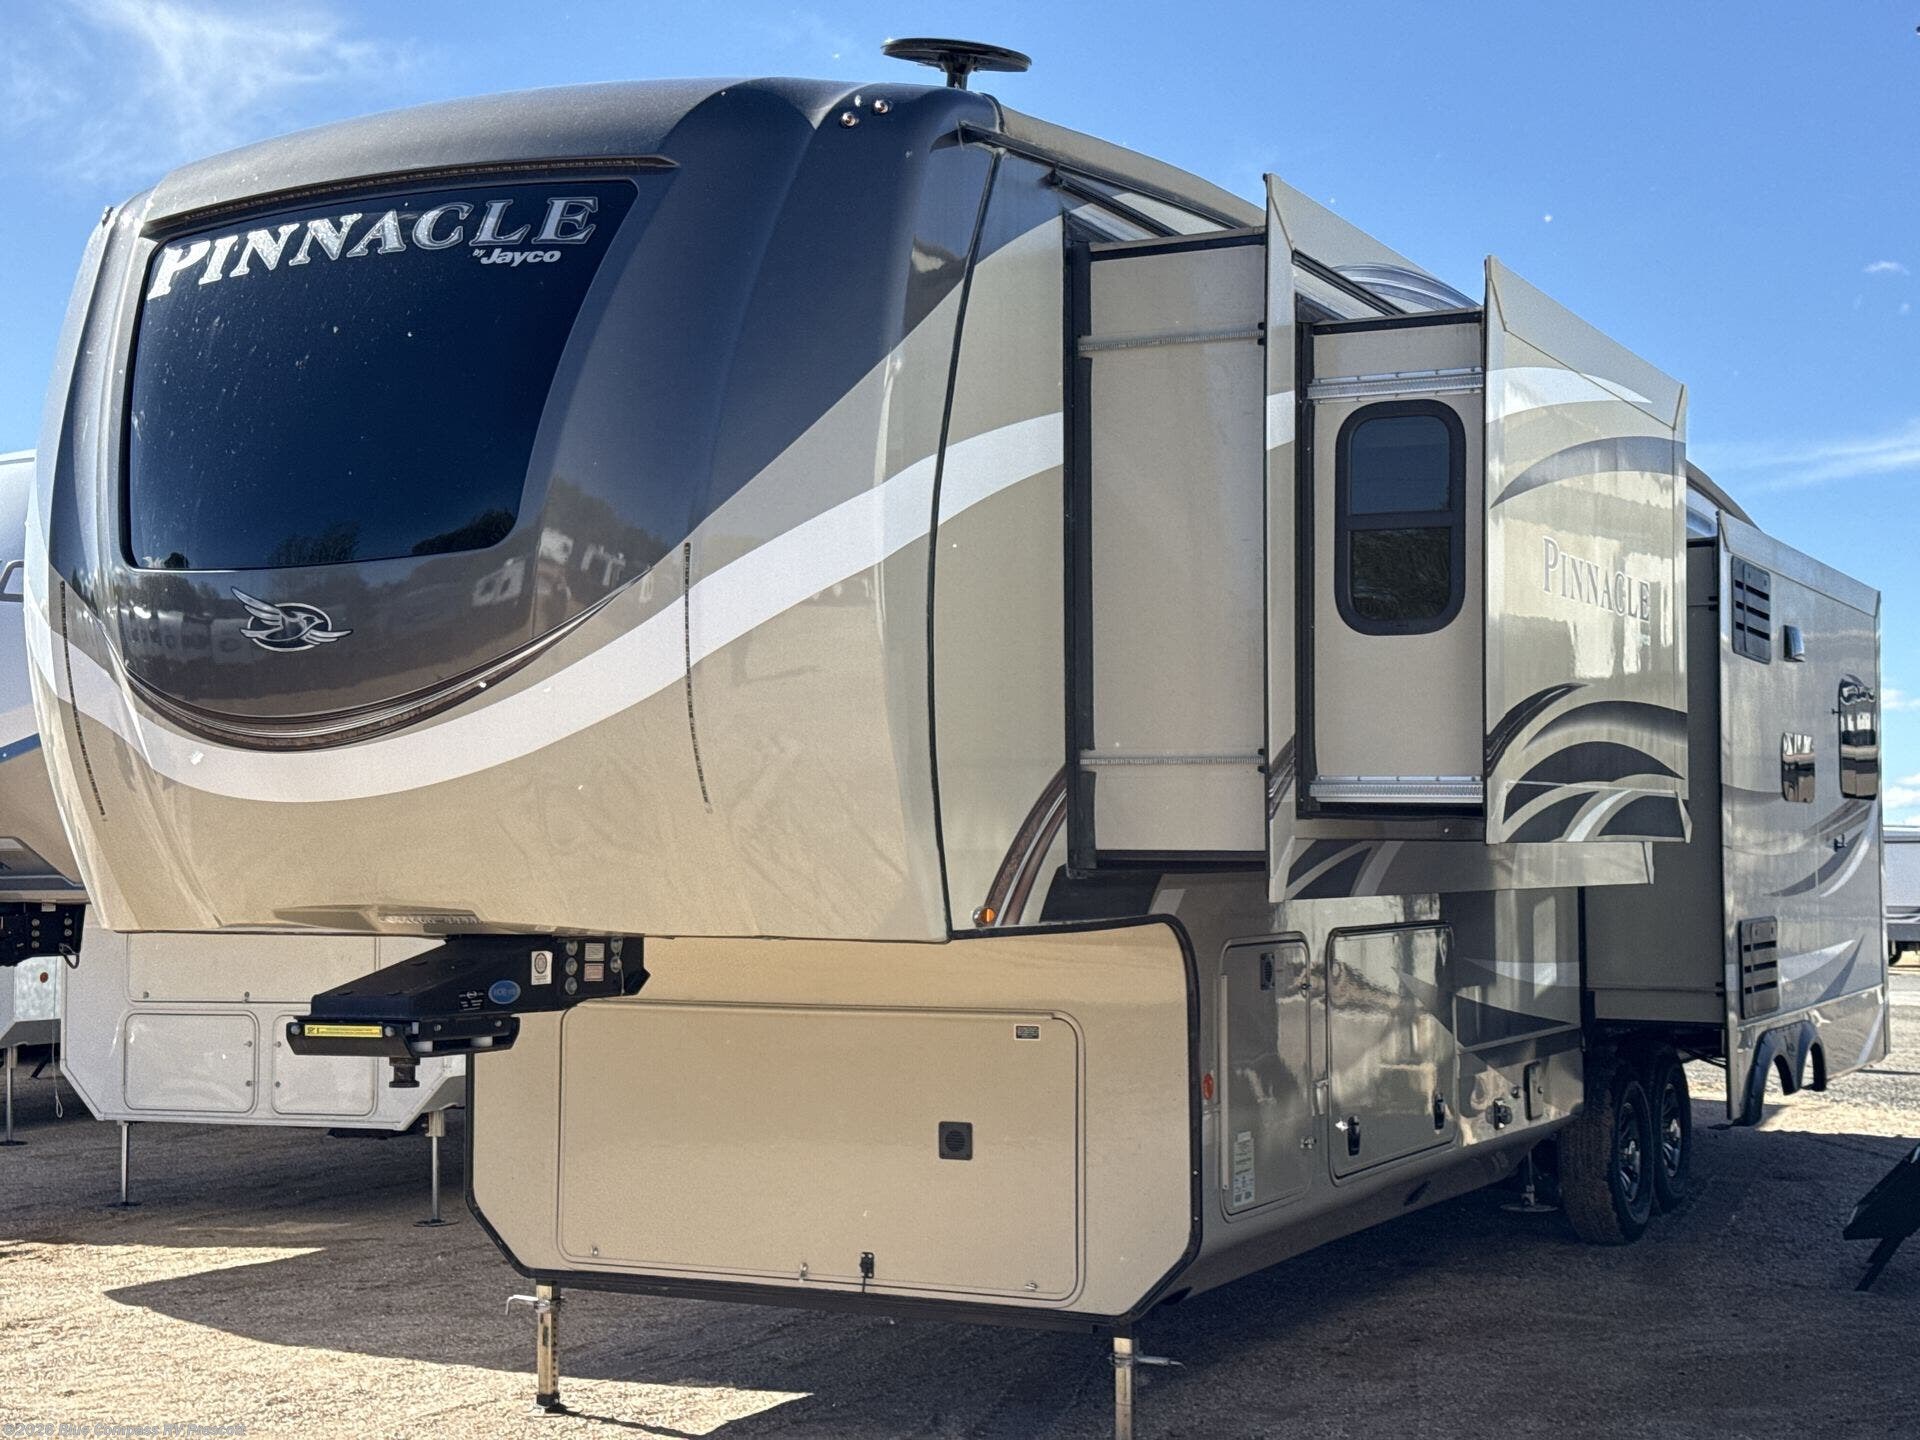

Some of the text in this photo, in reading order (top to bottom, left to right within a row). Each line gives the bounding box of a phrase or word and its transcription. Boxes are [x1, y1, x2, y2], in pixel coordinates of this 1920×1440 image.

[147, 196, 599, 301] PINNACLE
[472, 248, 562, 267] by Jayco
[1542, 535, 1650, 622] PINNACLE
